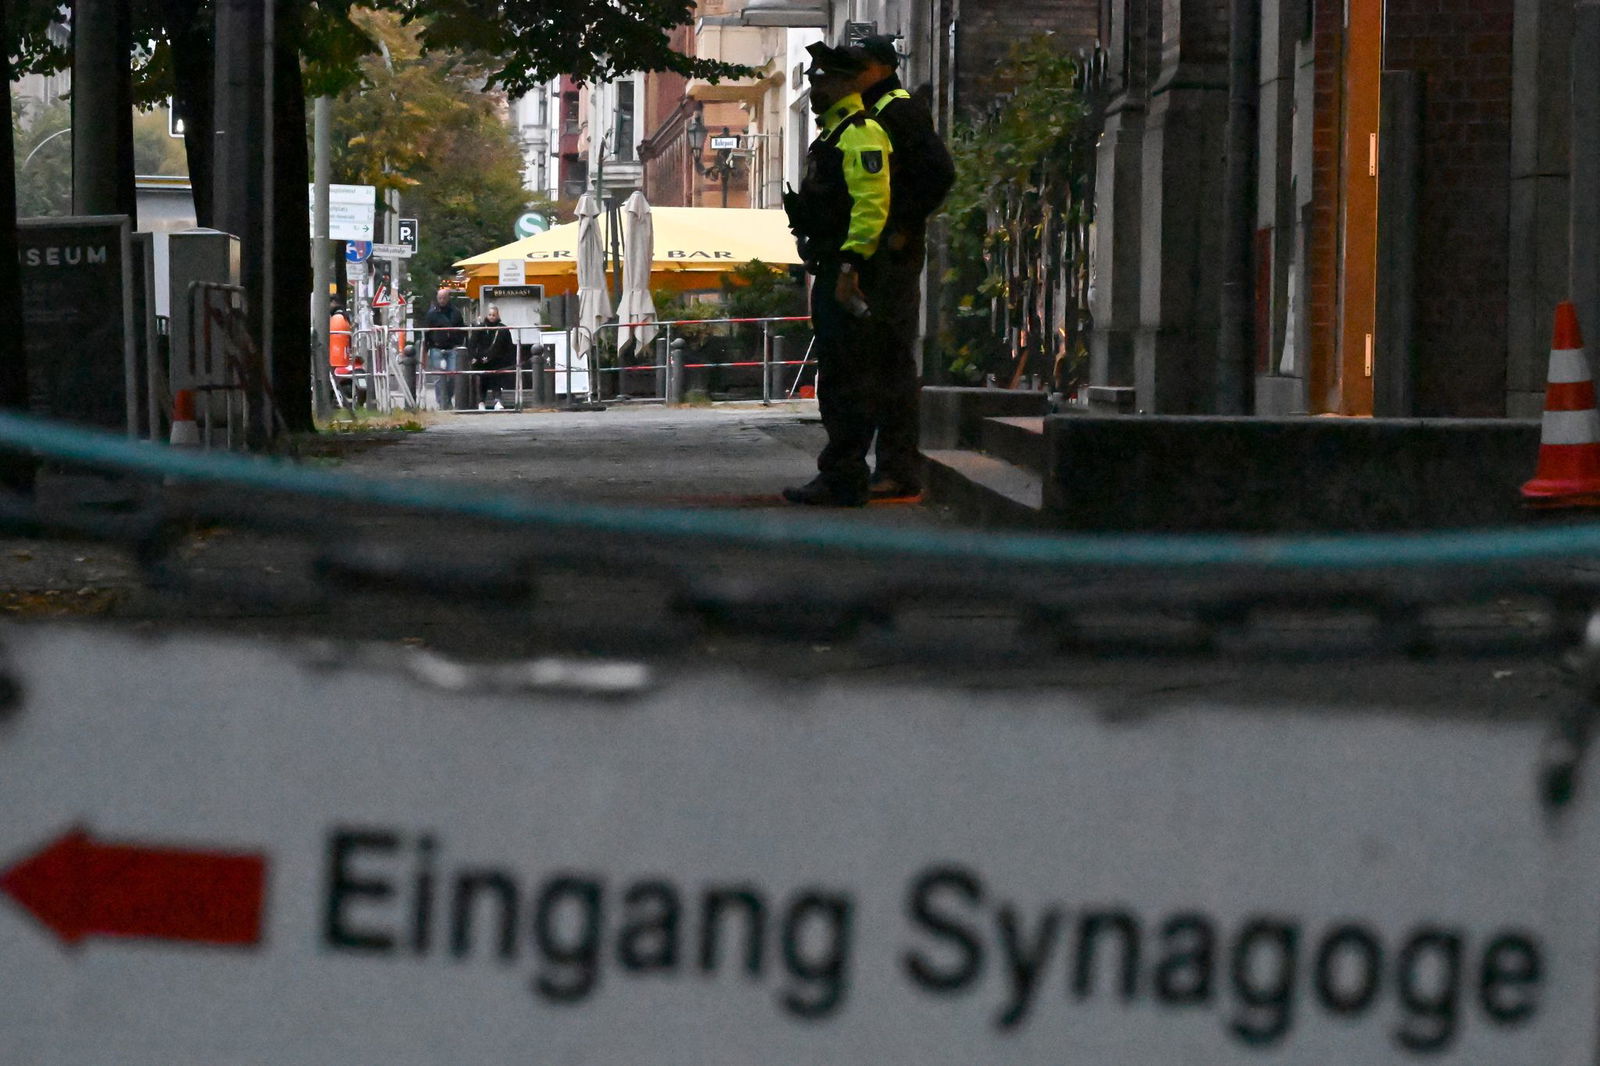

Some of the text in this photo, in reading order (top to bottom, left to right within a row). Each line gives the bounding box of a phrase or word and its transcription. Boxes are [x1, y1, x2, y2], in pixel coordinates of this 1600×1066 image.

[18, 246, 107, 266] SEUM
[667, 250, 735, 259] BAR
[321, 826, 1547, 1055] Eingang Synagoge
